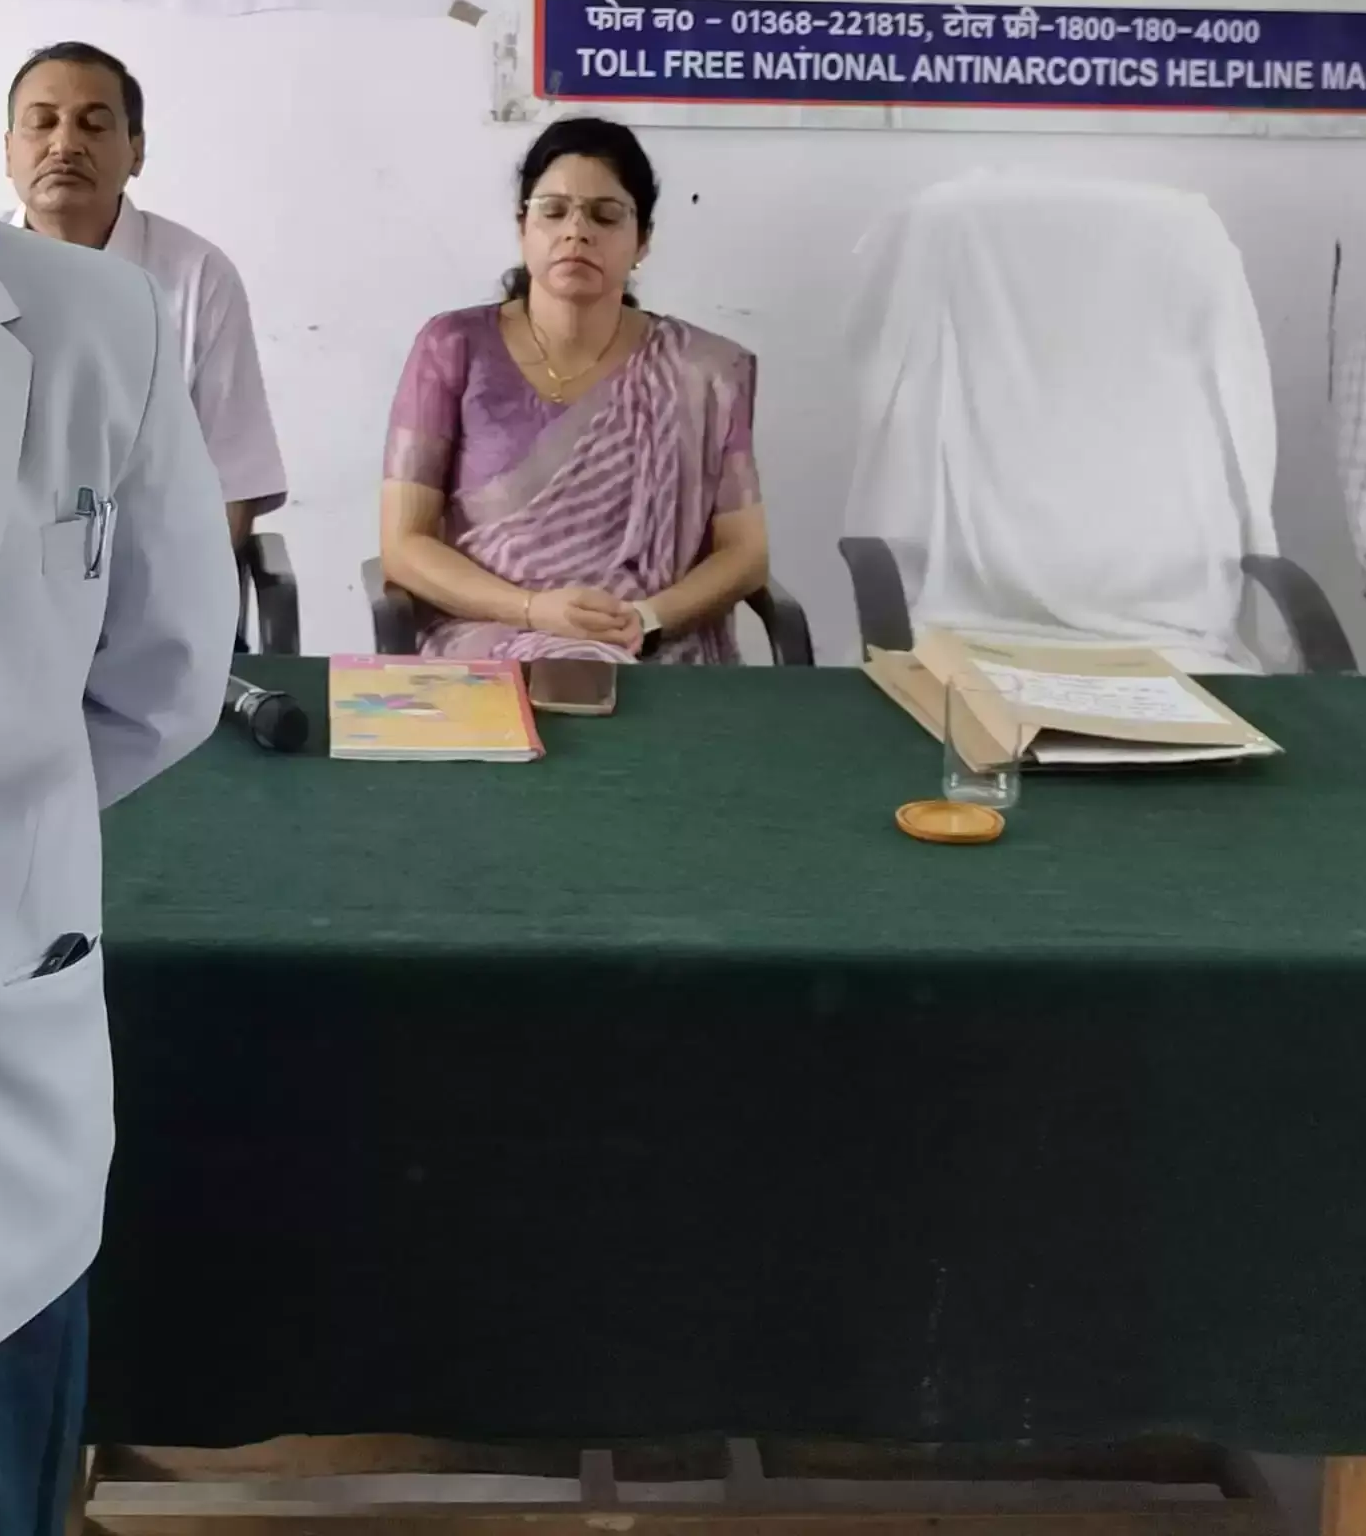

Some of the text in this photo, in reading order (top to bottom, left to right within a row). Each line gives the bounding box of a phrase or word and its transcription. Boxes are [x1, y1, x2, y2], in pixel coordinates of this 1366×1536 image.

[730, 10, 933, 43] 01368-221815,
[942, 4, 994, 40] टोल
[576, 48, 658, 79] TOLL
[663, 50, 745, 80] FREE
[753, 51, 907, 83] NATIONAL
[911, 54, 1159, 88] ANTINARCOTICS
[1166, 59, 1313, 91] HELPLINE
